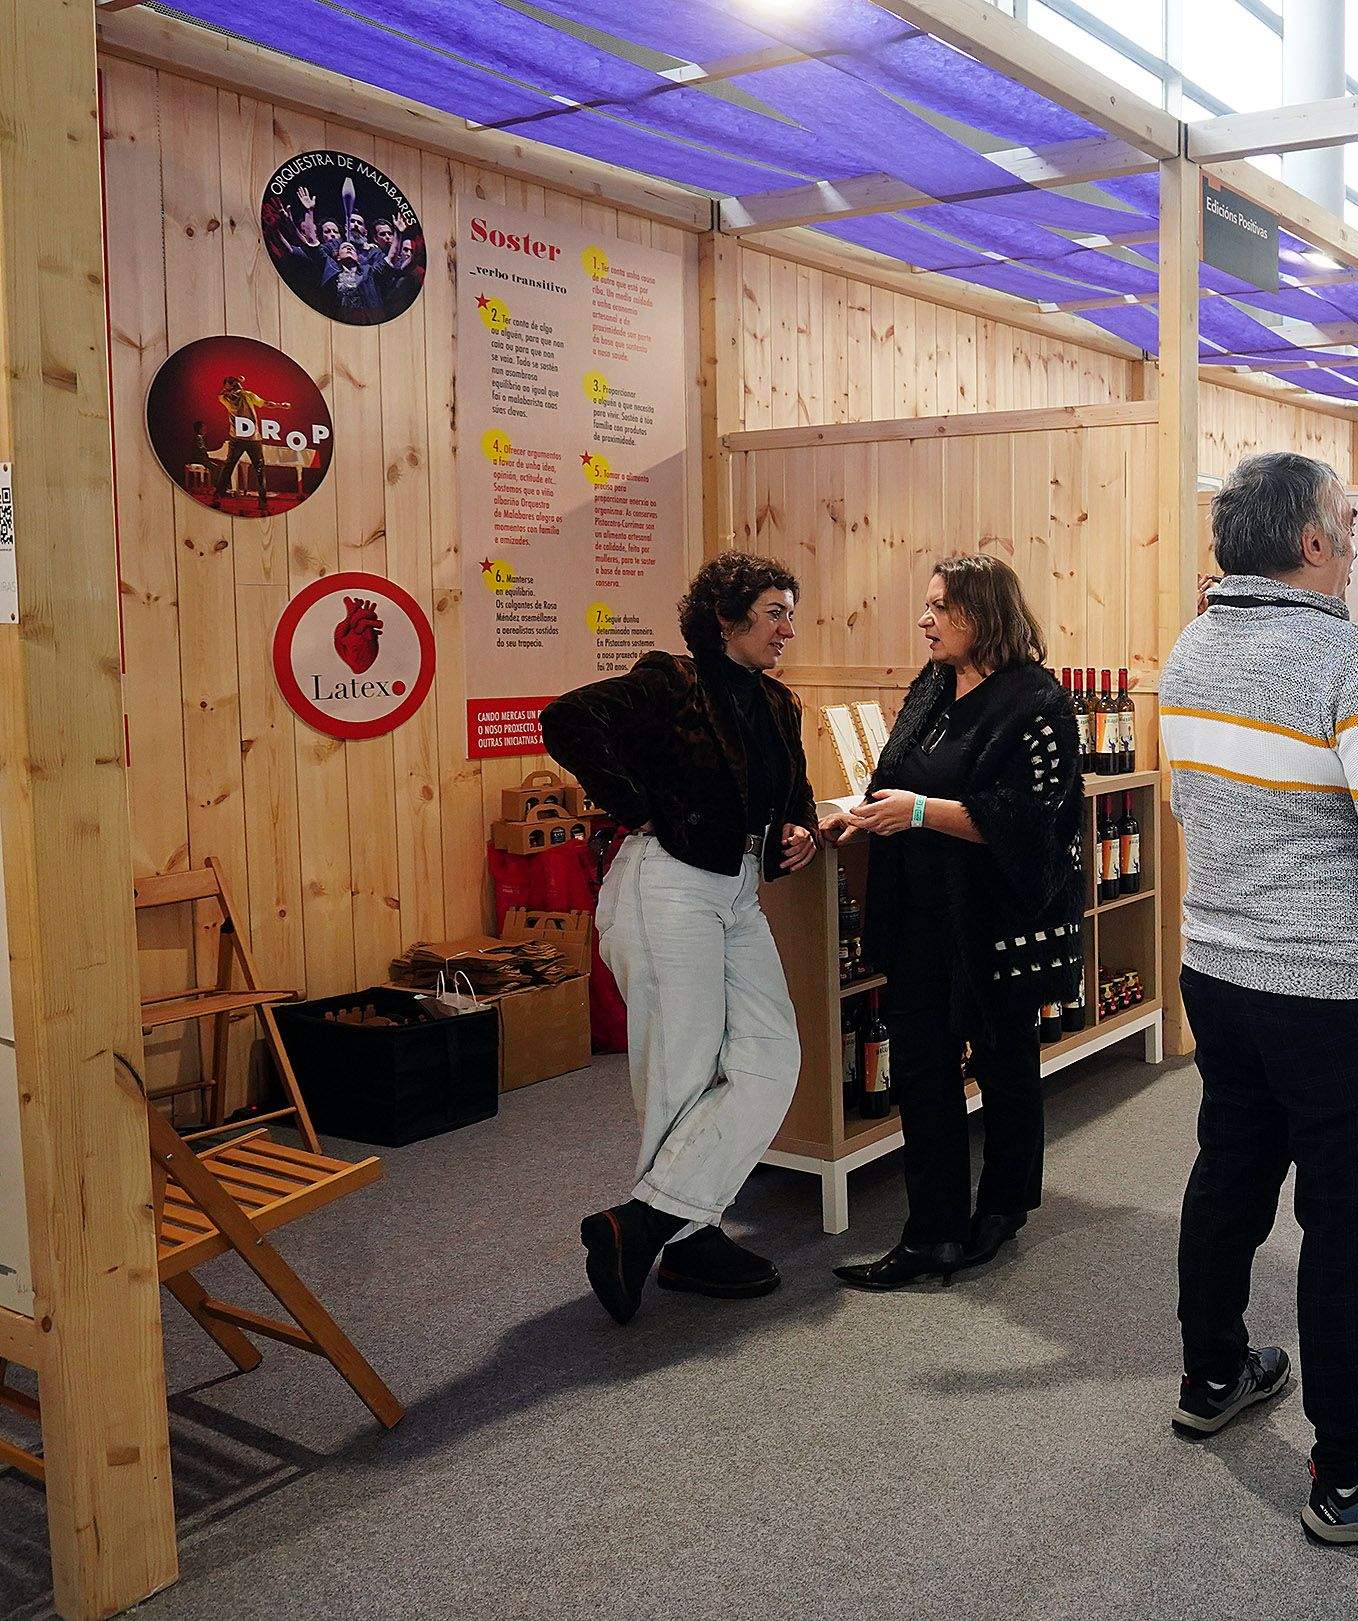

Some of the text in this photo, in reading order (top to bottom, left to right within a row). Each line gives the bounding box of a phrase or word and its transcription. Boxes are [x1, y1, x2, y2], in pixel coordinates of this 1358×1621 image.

[271, 154, 416, 226] ORQUESTRA DE MALABARES
[1207, 197, 1268, 239] Edicións Positivas
[470, 217, 561, 261] Soster
[512, 274, 567, 294] transitivo
[491, 308, 500, 322] 2.
[593, 380, 601, 392] 3.
[235, 416, 329, 452] DROP
[493, 439, 502, 453] 4.
[595, 465, 602, 477] 5.
[496, 570, 504, 582] 6.
[597, 611, 603, 623] 7.
[606, 662, 613, 671] 20
[478, 712, 500, 722] CANDO
[502, 711, 525, 720] MERCAS
[527, 711, 536, 719] UN
[478, 725, 483, 735] O
[485, 725, 502, 734] NOSO
[504, 723, 536, 733] PROXECTO,
[478, 738, 502, 748] OUTRAS
[504, 735, 538, 746] INICIATIVAS
